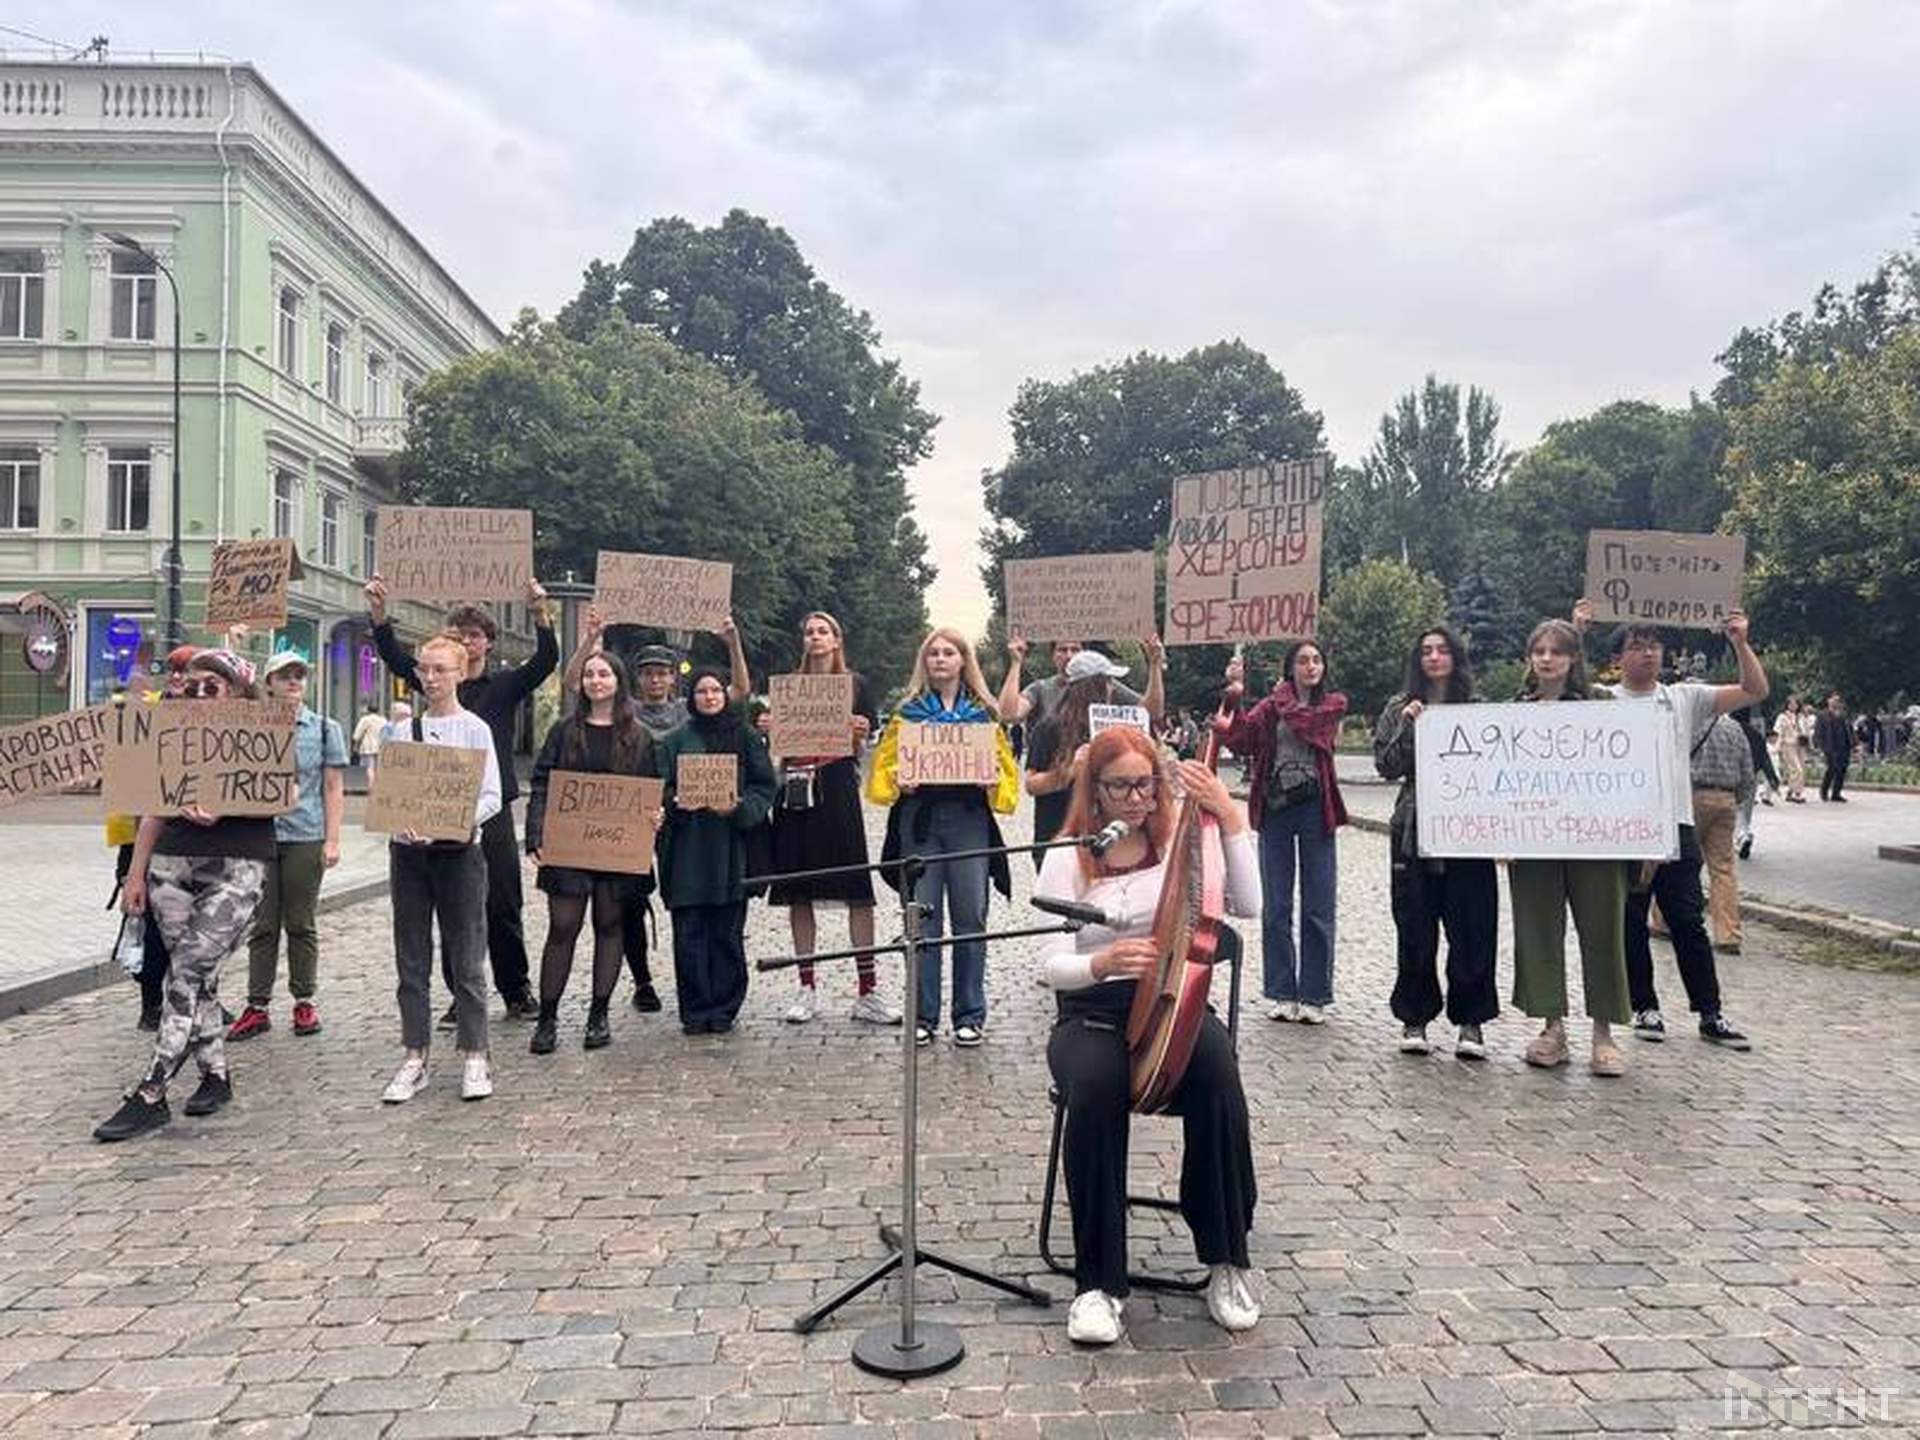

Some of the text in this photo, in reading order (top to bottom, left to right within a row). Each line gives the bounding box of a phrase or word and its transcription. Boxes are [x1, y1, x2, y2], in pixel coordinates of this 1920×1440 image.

[1175, 533, 1307, 577] ХЕРСОНУ
[1170, 591, 1316, 641] ФЕДОРОВА
[115, 702, 151, 746] IN
[1438, 723, 1631, 762] ДЯКУЄМО
[157, 727, 294, 765] FEDOROV
[160, 769, 294, 807] WE TRUST
[1439, 768, 1646, 801] ЗА ДРАПАТОГО
